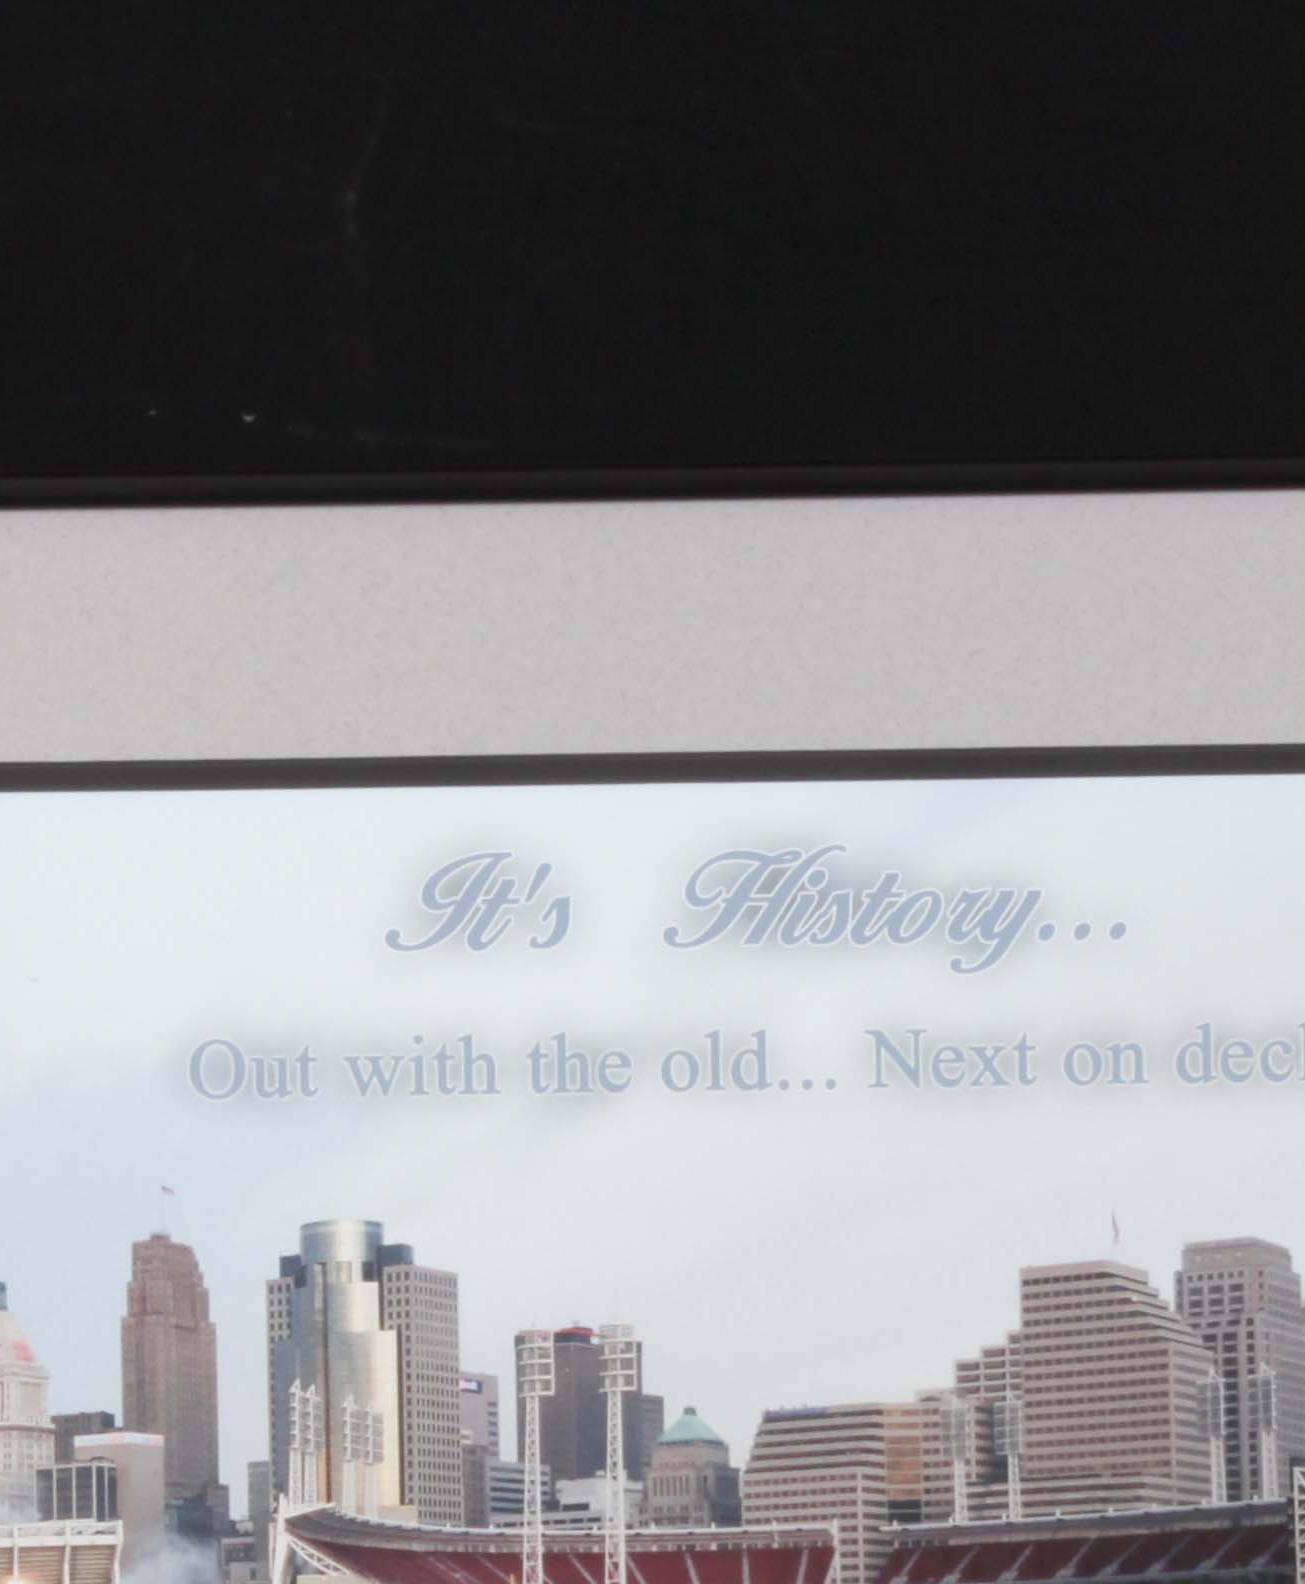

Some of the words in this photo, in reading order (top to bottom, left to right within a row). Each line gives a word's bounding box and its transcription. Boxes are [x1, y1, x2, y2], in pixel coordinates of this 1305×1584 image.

[384, 848, 573, 952] It's
[662, 844, 1129, 974] History...
[188, 1037, 320, 1101] Out
[343, 1032, 501, 1098] with
[527, 1030, 635, 1095] the
[660, 1029, 840, 1095] old...
[864, 1028, 1037, 1090] Next
[1061, 1040, 1149, 1086] on
